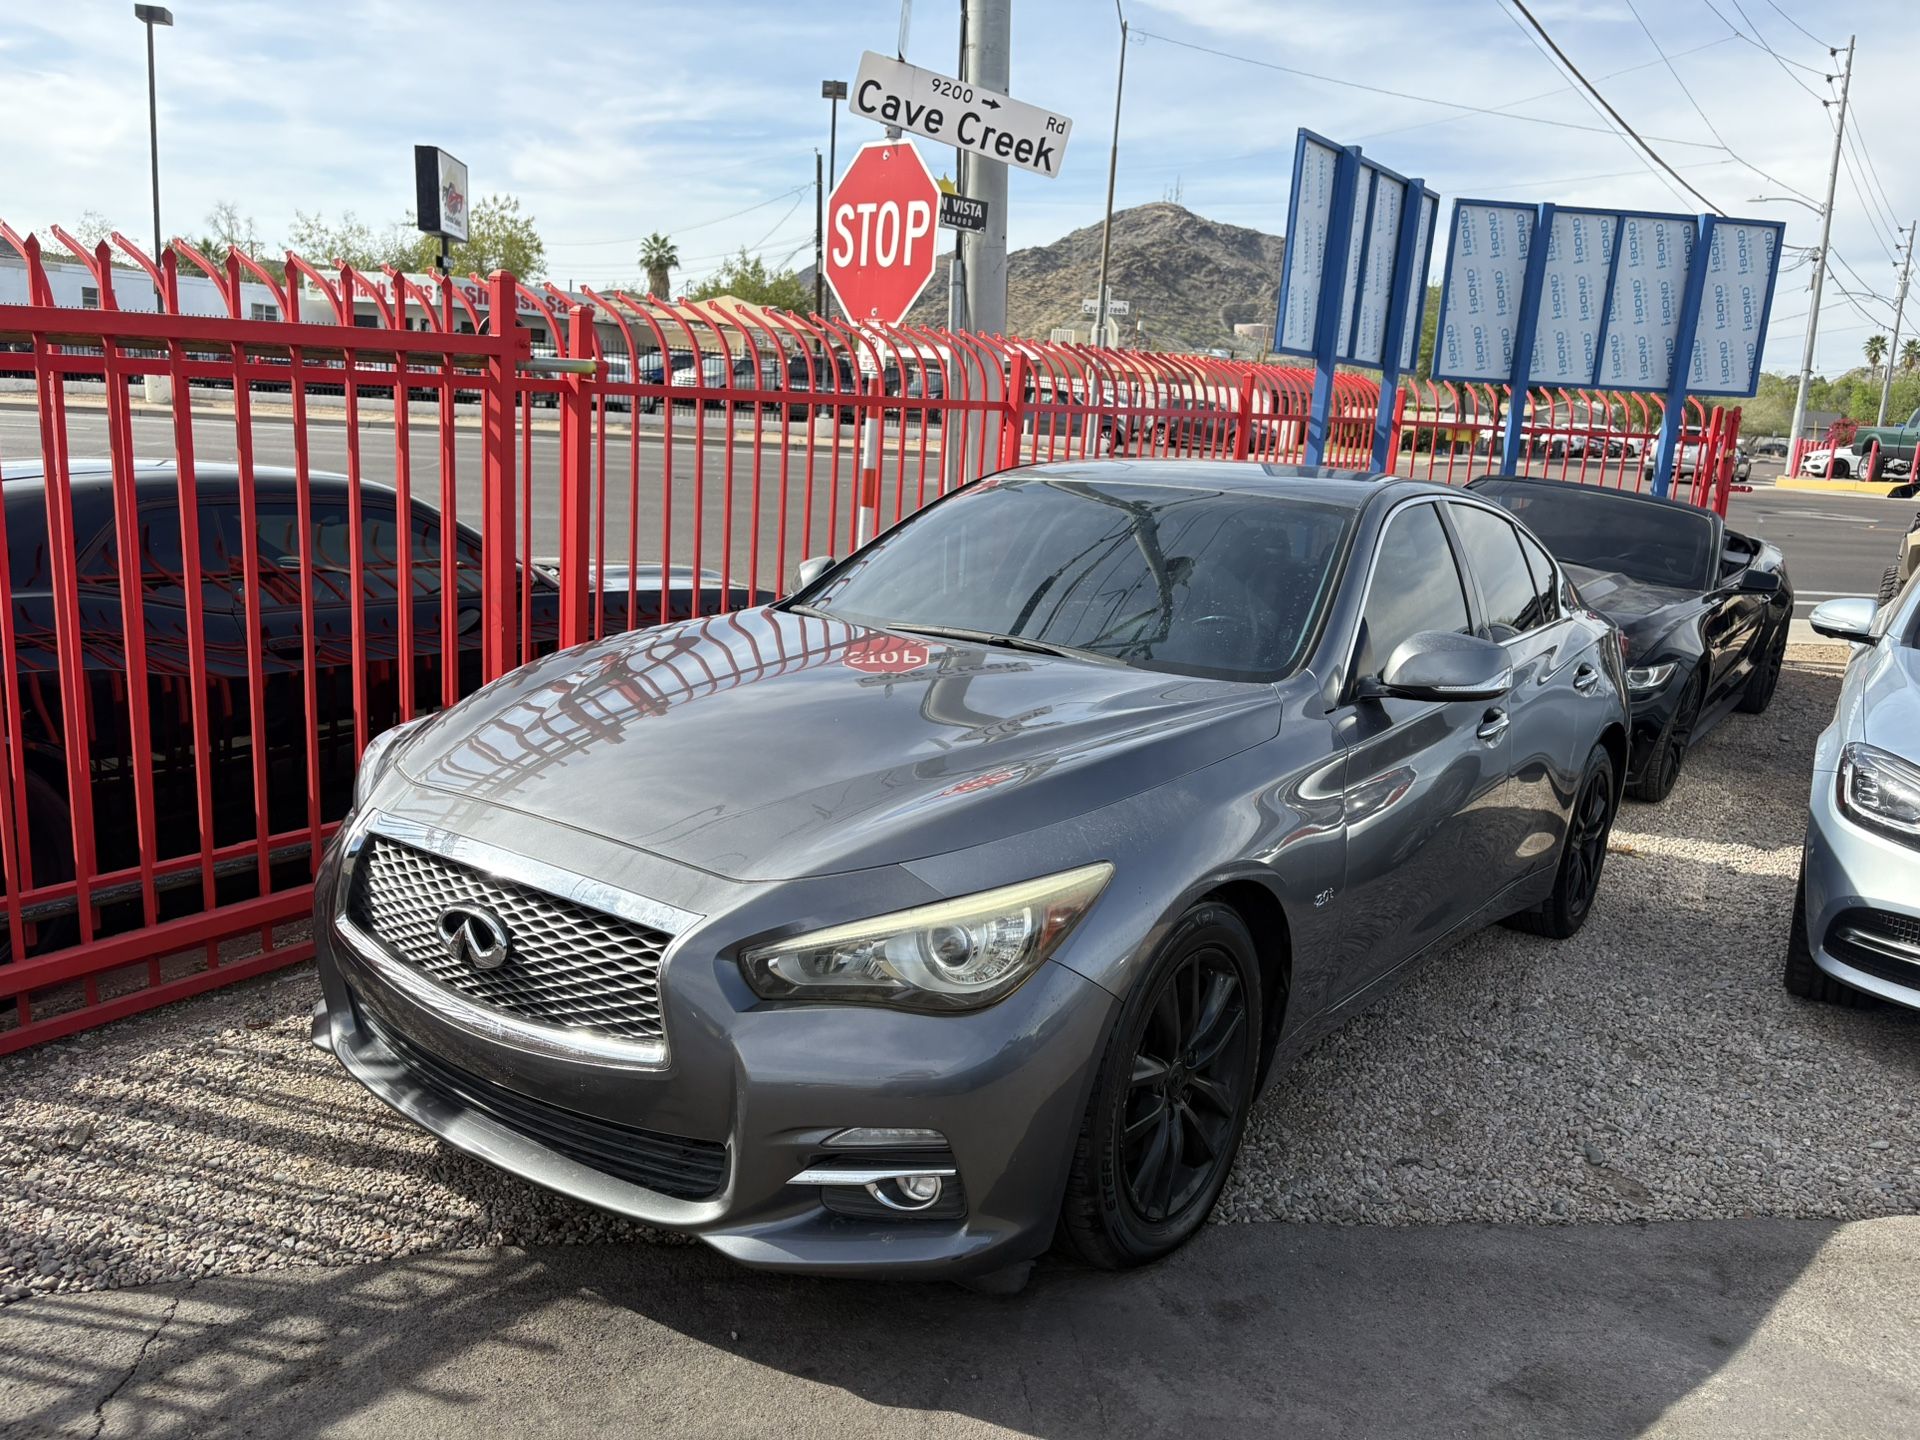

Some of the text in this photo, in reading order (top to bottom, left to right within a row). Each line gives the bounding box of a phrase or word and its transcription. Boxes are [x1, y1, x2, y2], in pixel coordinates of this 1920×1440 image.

[931, 78, 973, 103] 9200
[858, 79, 1055, 172] Cave Creek
[1046, 116, 1066, 135] Rd
[952, 198, 983, 219] VISTA
[832, 200, 931, 268] STOP
[1083, 304, 1127, 314] Cav reek
